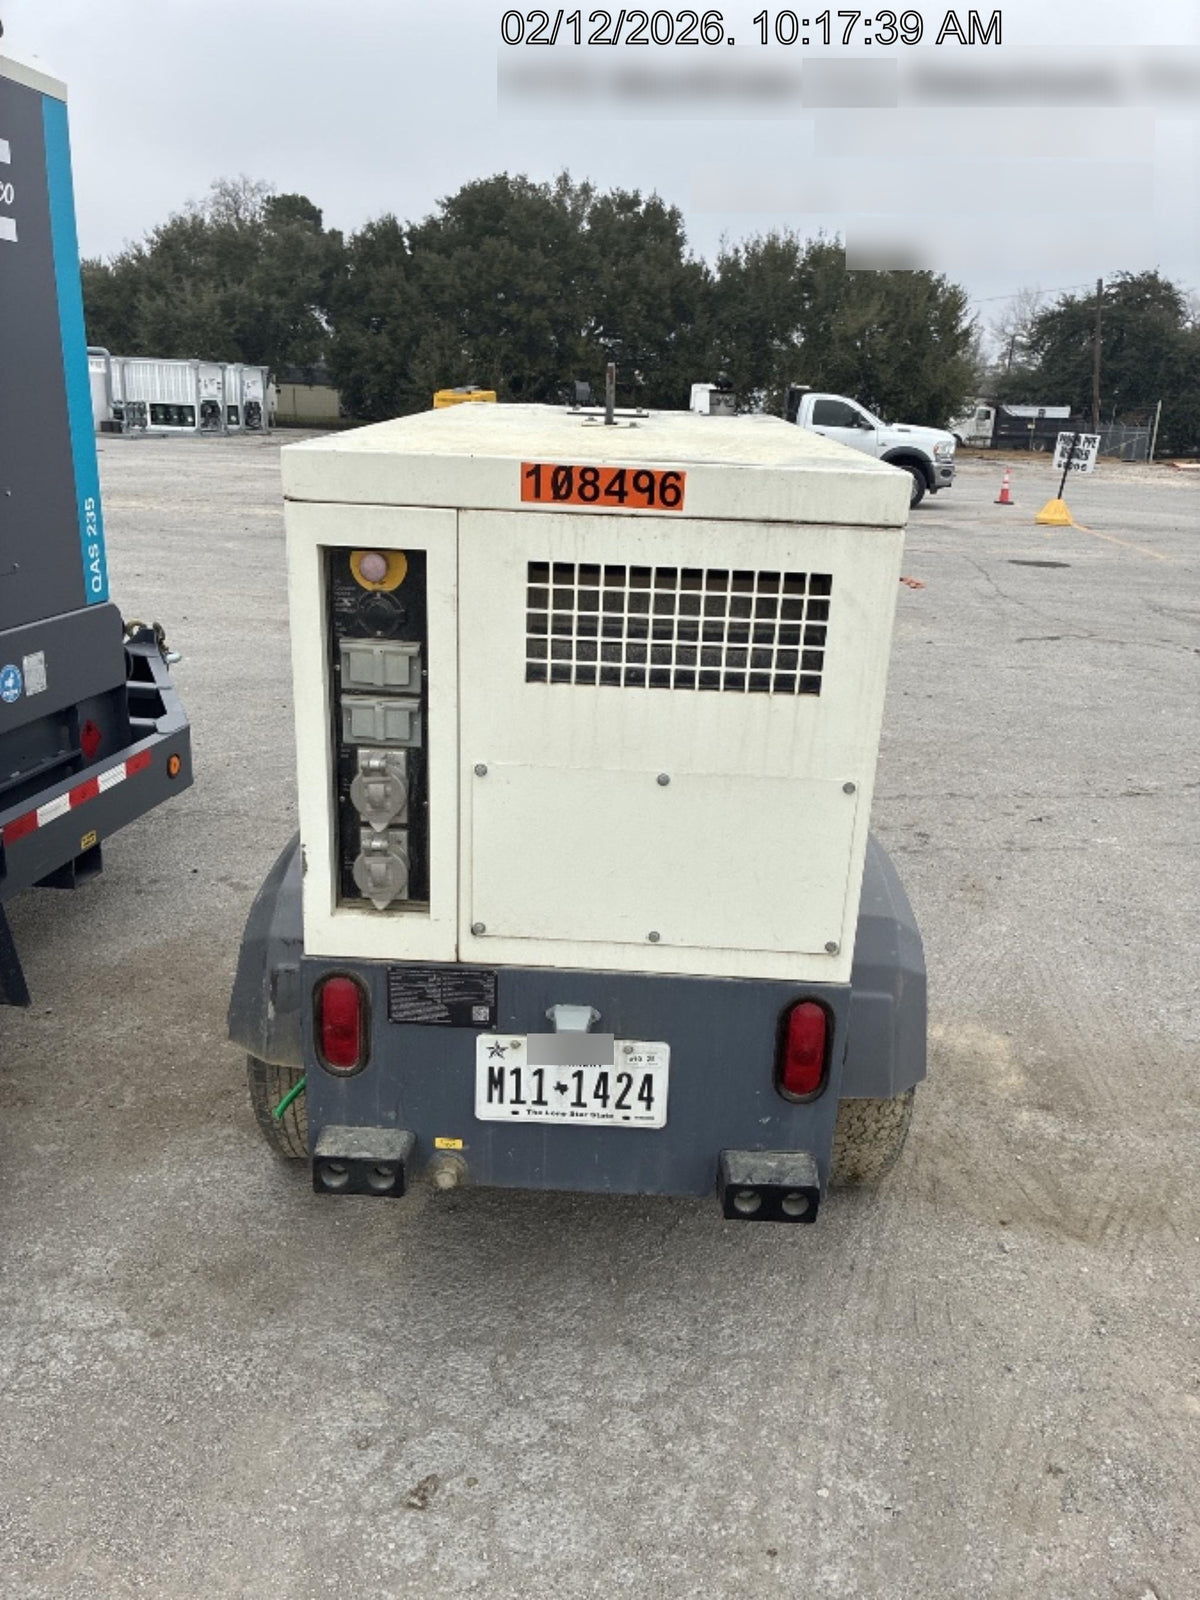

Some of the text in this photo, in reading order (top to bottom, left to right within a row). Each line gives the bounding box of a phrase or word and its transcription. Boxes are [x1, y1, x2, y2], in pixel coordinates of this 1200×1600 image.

[525, 463, 682, 507] 108496
[84, 497, 102, 593] QAS 235
[486, 1066, 655, 1111] M11 1424
